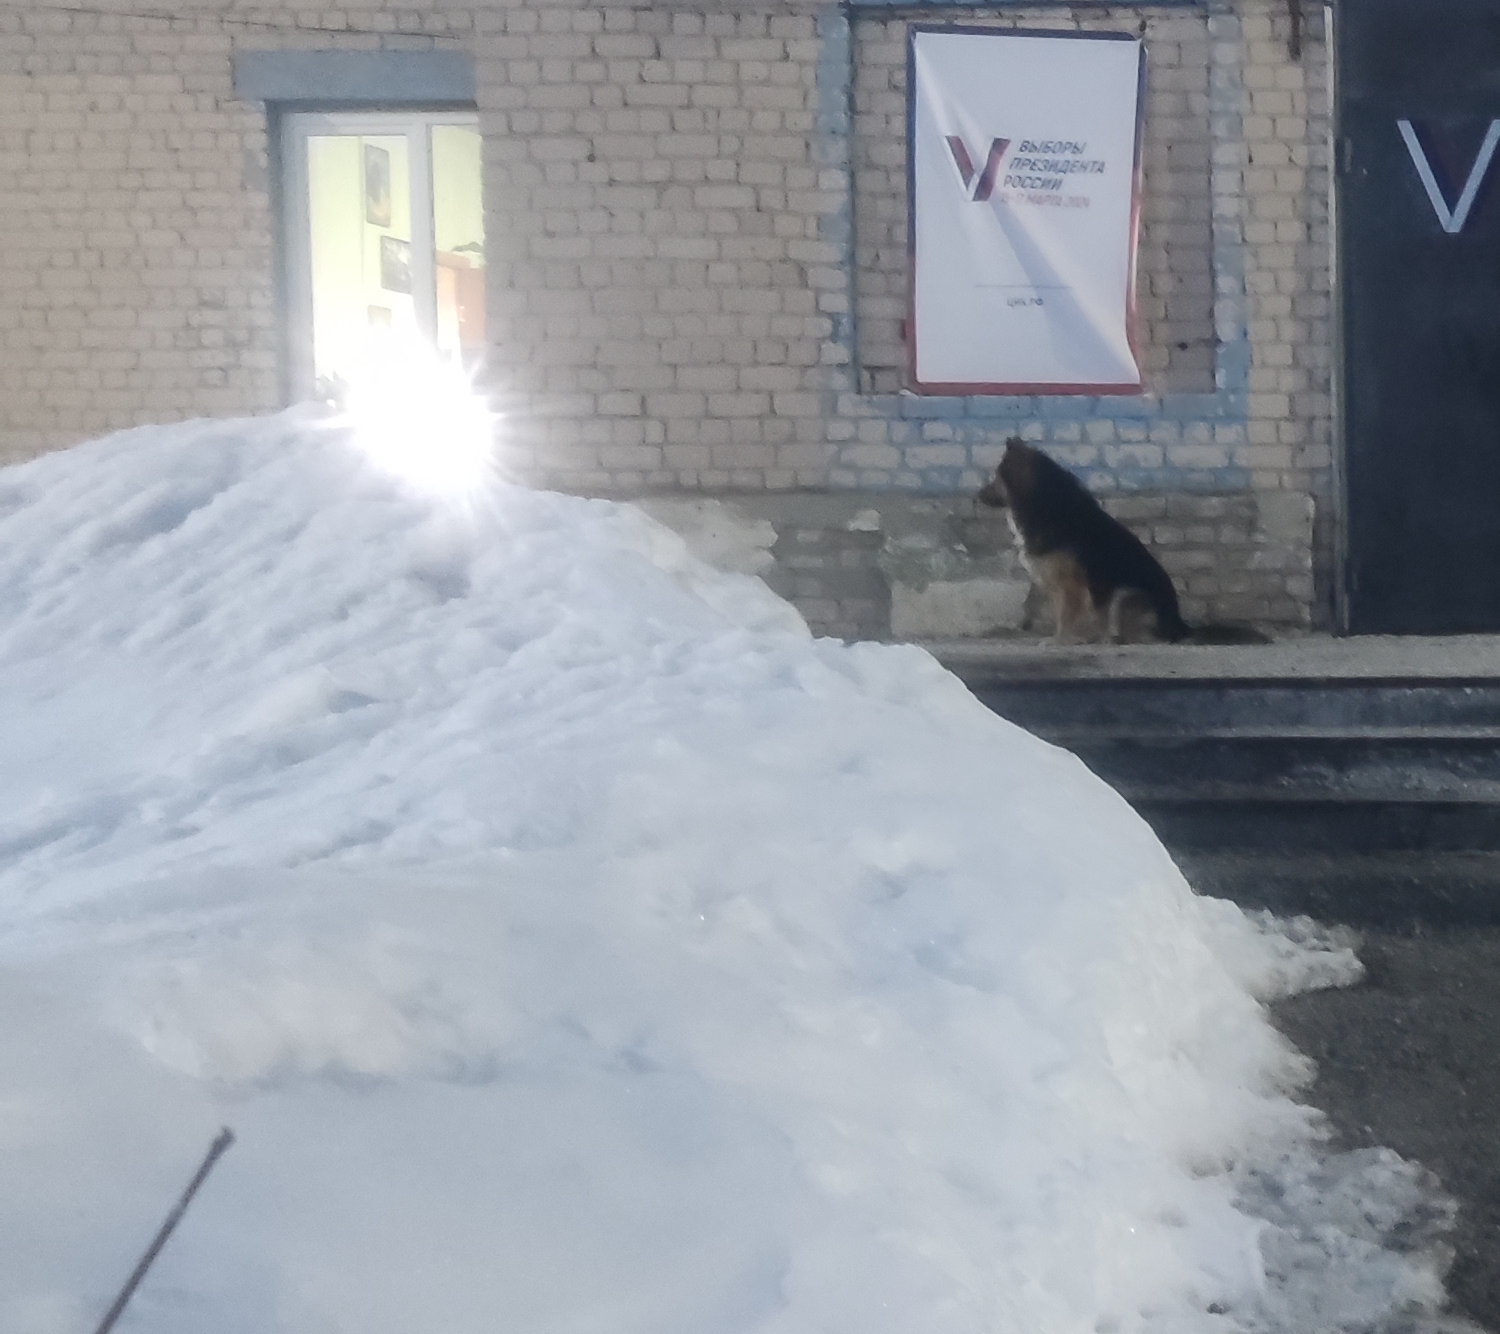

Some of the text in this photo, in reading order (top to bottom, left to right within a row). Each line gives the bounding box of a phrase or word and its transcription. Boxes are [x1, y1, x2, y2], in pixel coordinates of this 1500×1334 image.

[1019, 140, 1087, 154] ВЫБОРЫ
[1009, 157, 1106, 175] ПРЕЗИДЕНТА
[1003, 174, 1064, 191] РОССИИ
